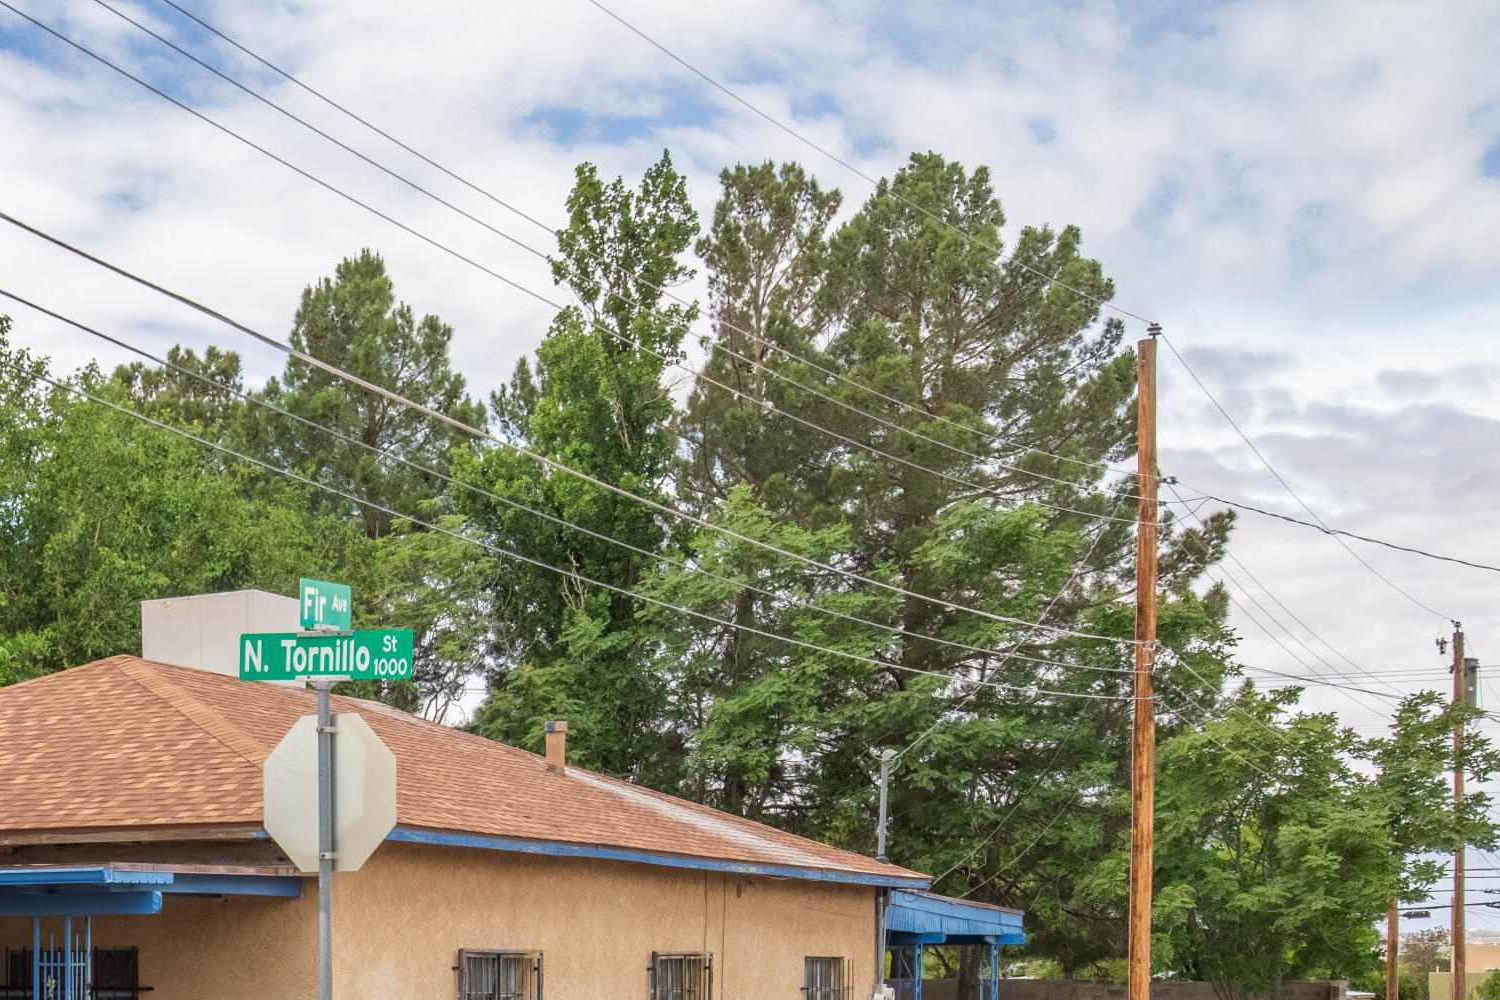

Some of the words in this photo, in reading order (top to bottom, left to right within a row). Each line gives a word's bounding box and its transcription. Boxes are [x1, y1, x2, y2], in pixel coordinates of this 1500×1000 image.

[303, 586, 327, 622] Fir
[332, 594, 348, 613] Ave
[244, 639, 269, 673] N.
[281, 639, 370, 672] Tornillo
[382, 635, 397, 653] St
[374, 658, 408, 676] 1000
